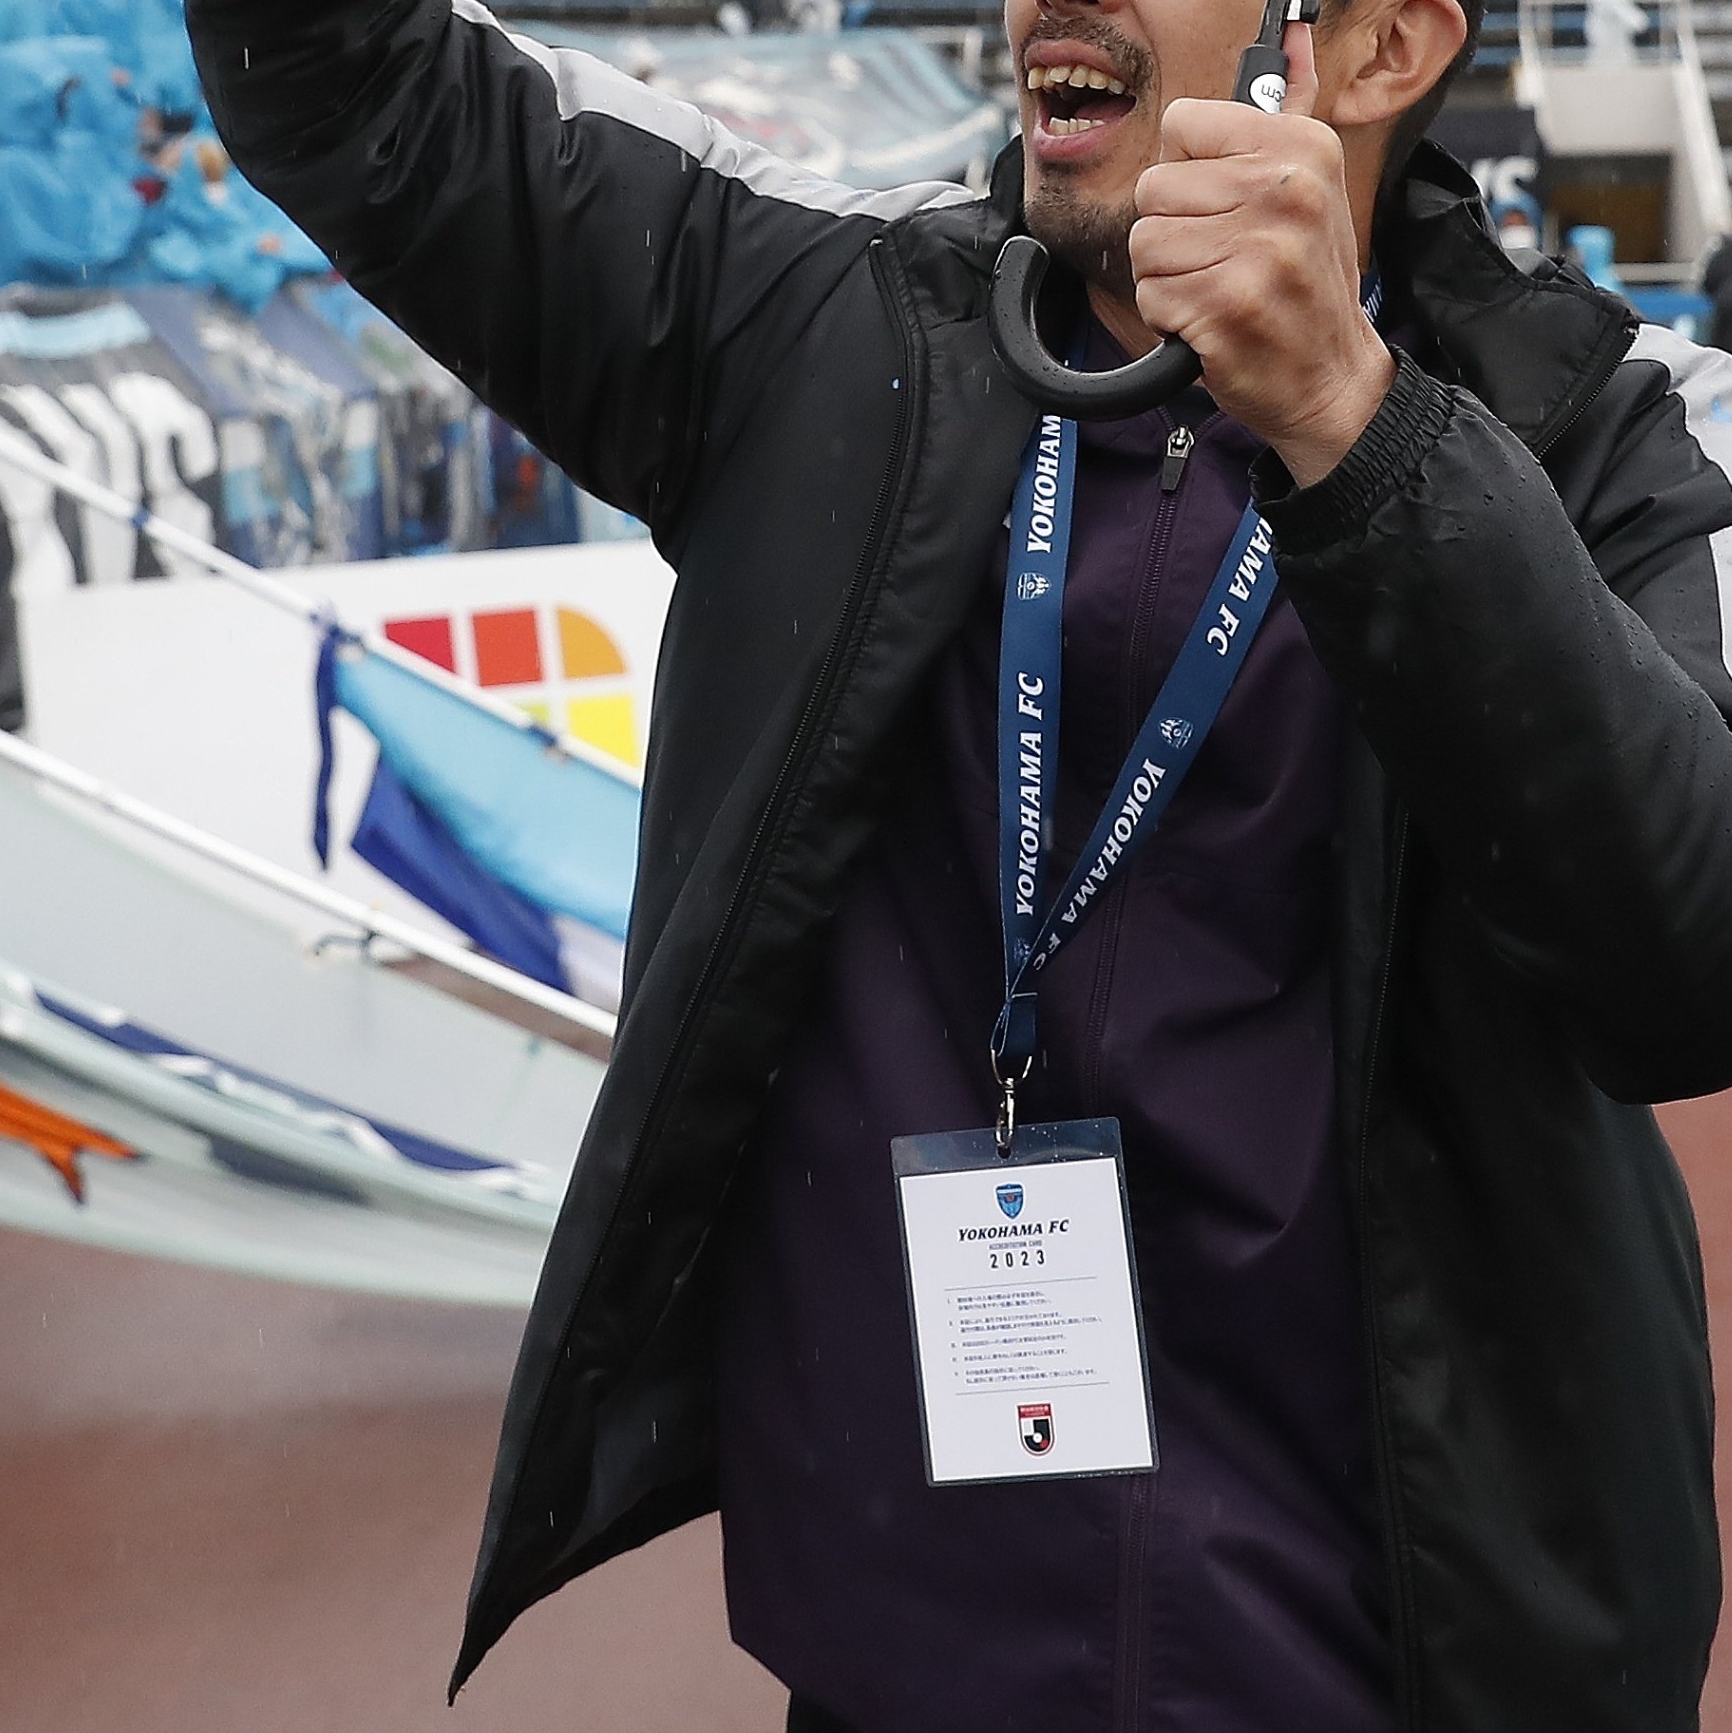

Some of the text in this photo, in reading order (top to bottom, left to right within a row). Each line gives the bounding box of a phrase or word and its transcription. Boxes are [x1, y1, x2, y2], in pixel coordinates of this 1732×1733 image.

[1026, 415, 1062, 554] YOKOHAM
[1206, 603, 1240, 656] FC
[1016, 672, 1045, 915] YOKOHAMA FC
[1061, 757, 1166, 923] YOKOHAMA
[958, 1219, 1070, 1242] YOKOHAMA FC
[989, 1250, 1045, 1269] 2023
